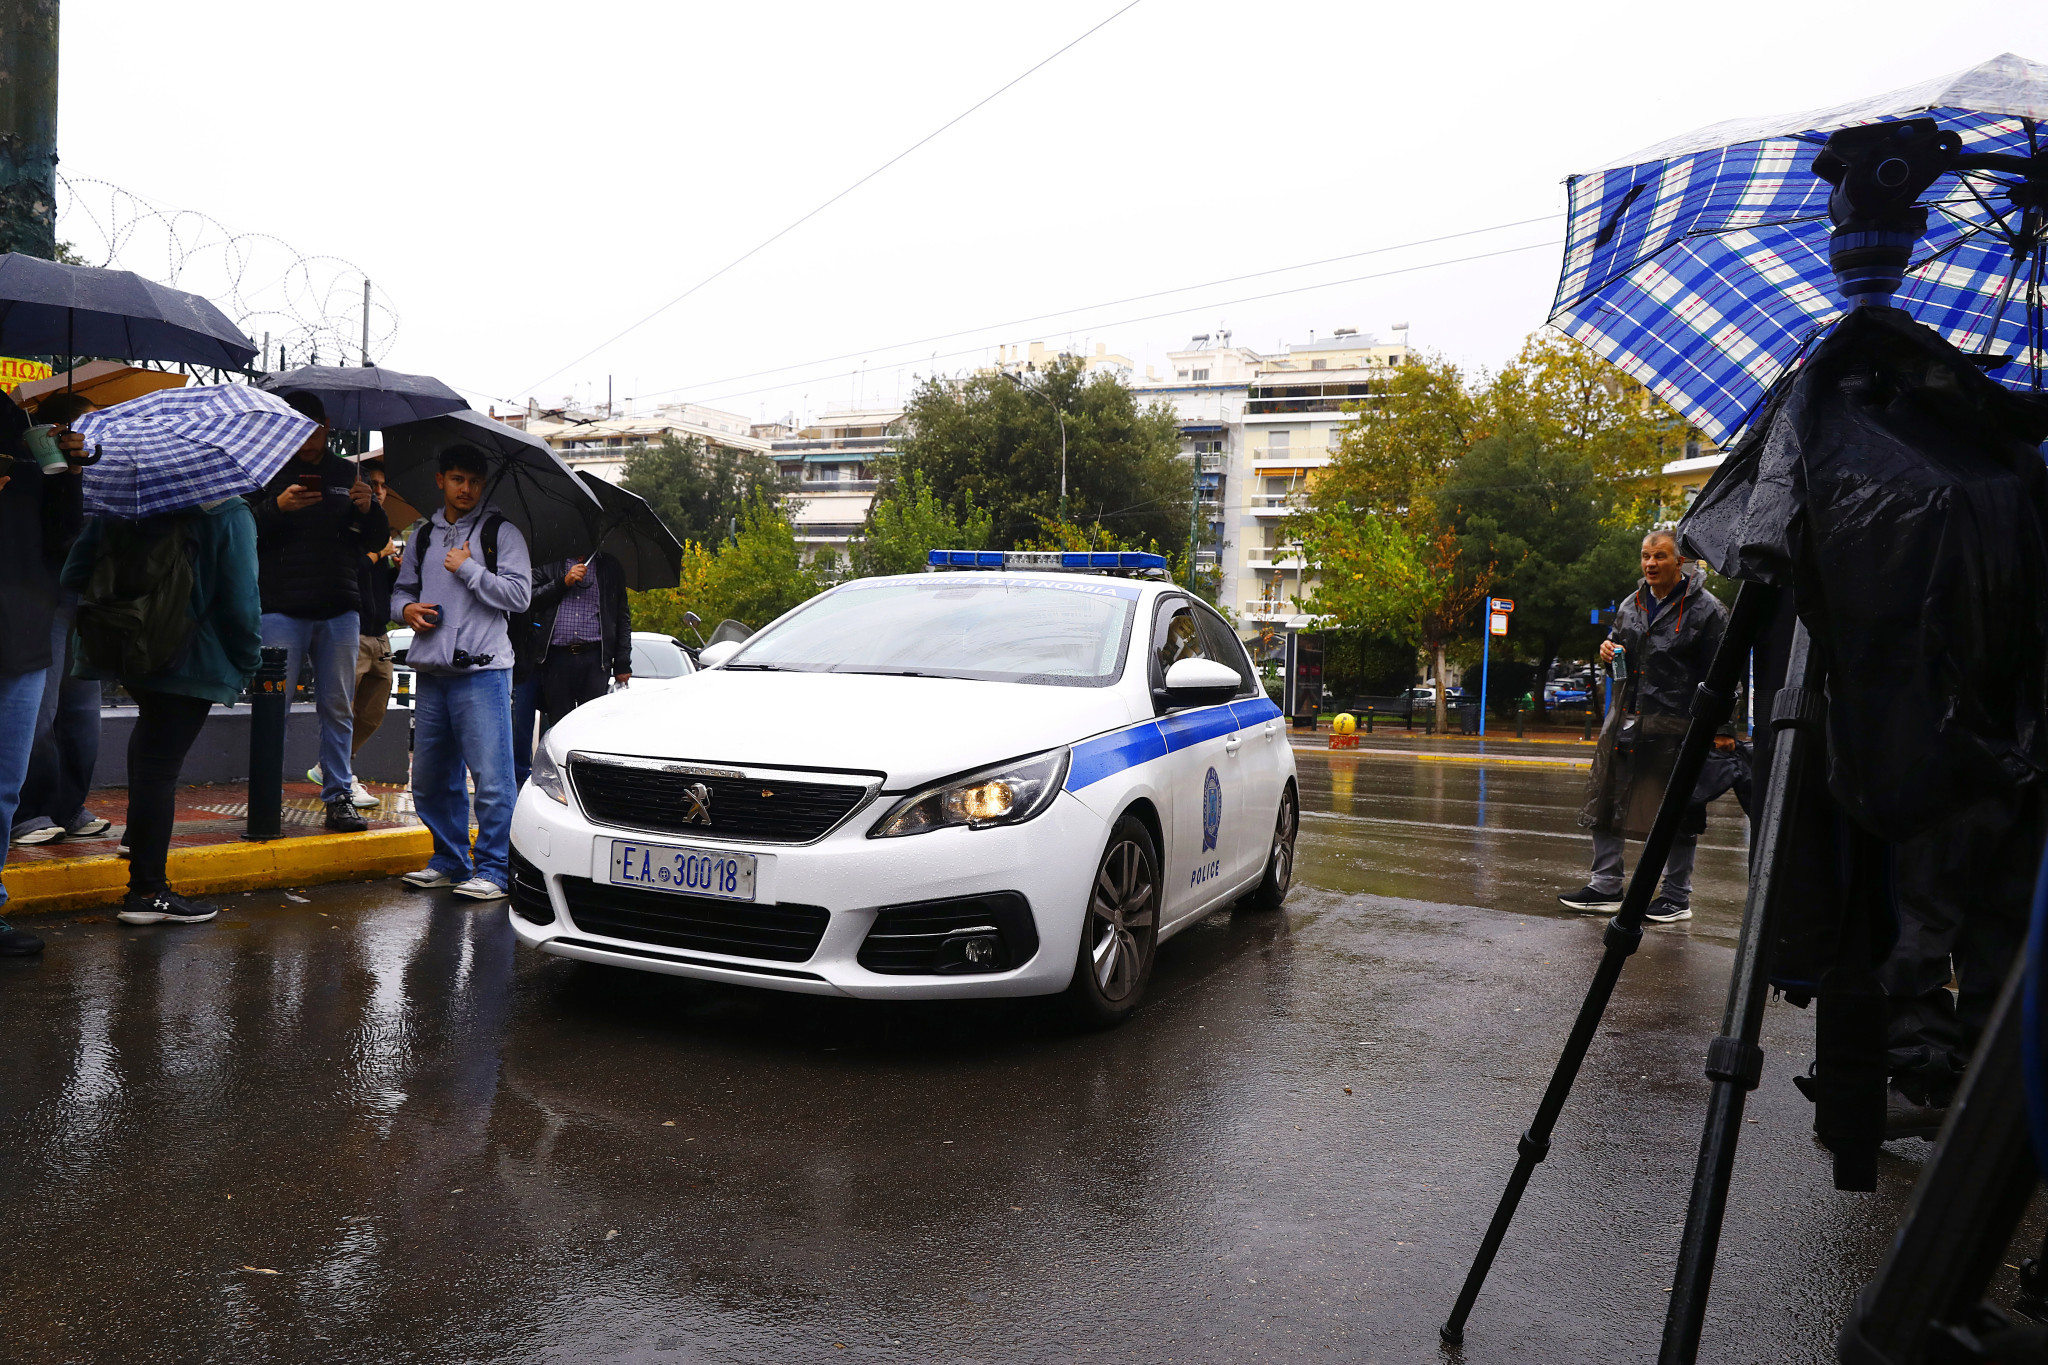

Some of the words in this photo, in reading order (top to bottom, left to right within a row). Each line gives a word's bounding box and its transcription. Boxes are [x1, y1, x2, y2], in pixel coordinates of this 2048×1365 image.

[975, 579, 1117, 596] ΑΣΤΥΝΟΜΙΑ
[673, 853, 737, 892] 30018
[1190, 860, 1220, 888] POLICE
